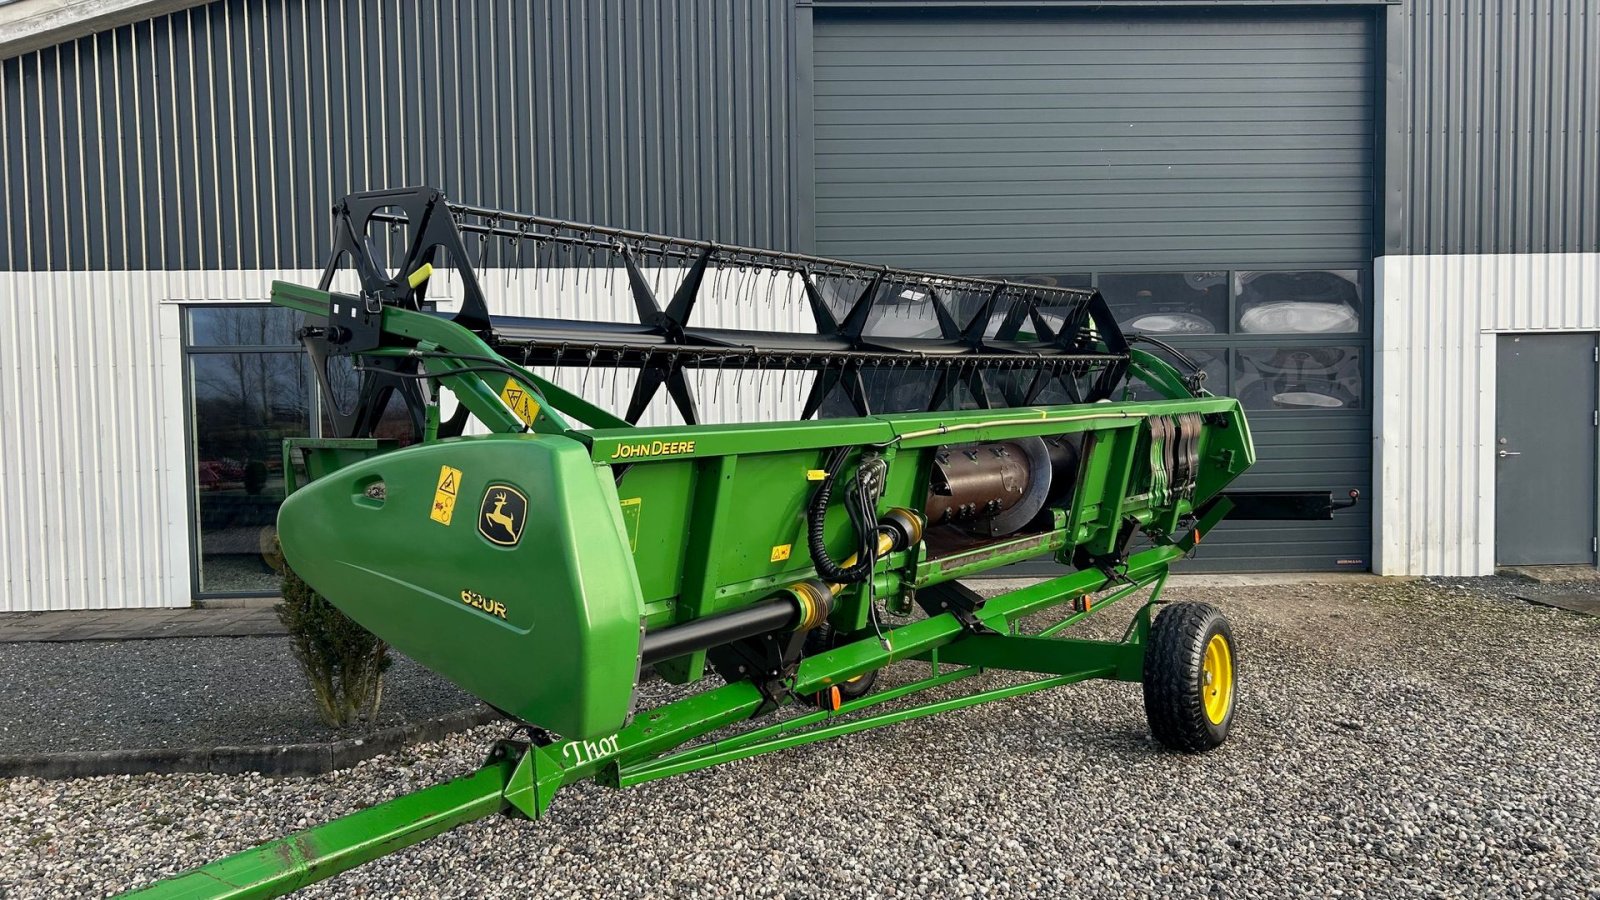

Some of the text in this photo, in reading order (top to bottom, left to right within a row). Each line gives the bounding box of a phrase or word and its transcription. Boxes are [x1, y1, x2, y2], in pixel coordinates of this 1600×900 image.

[611, 440, 696, 459] JOHN DEERE
[562, 733, 619, 767] Thor
